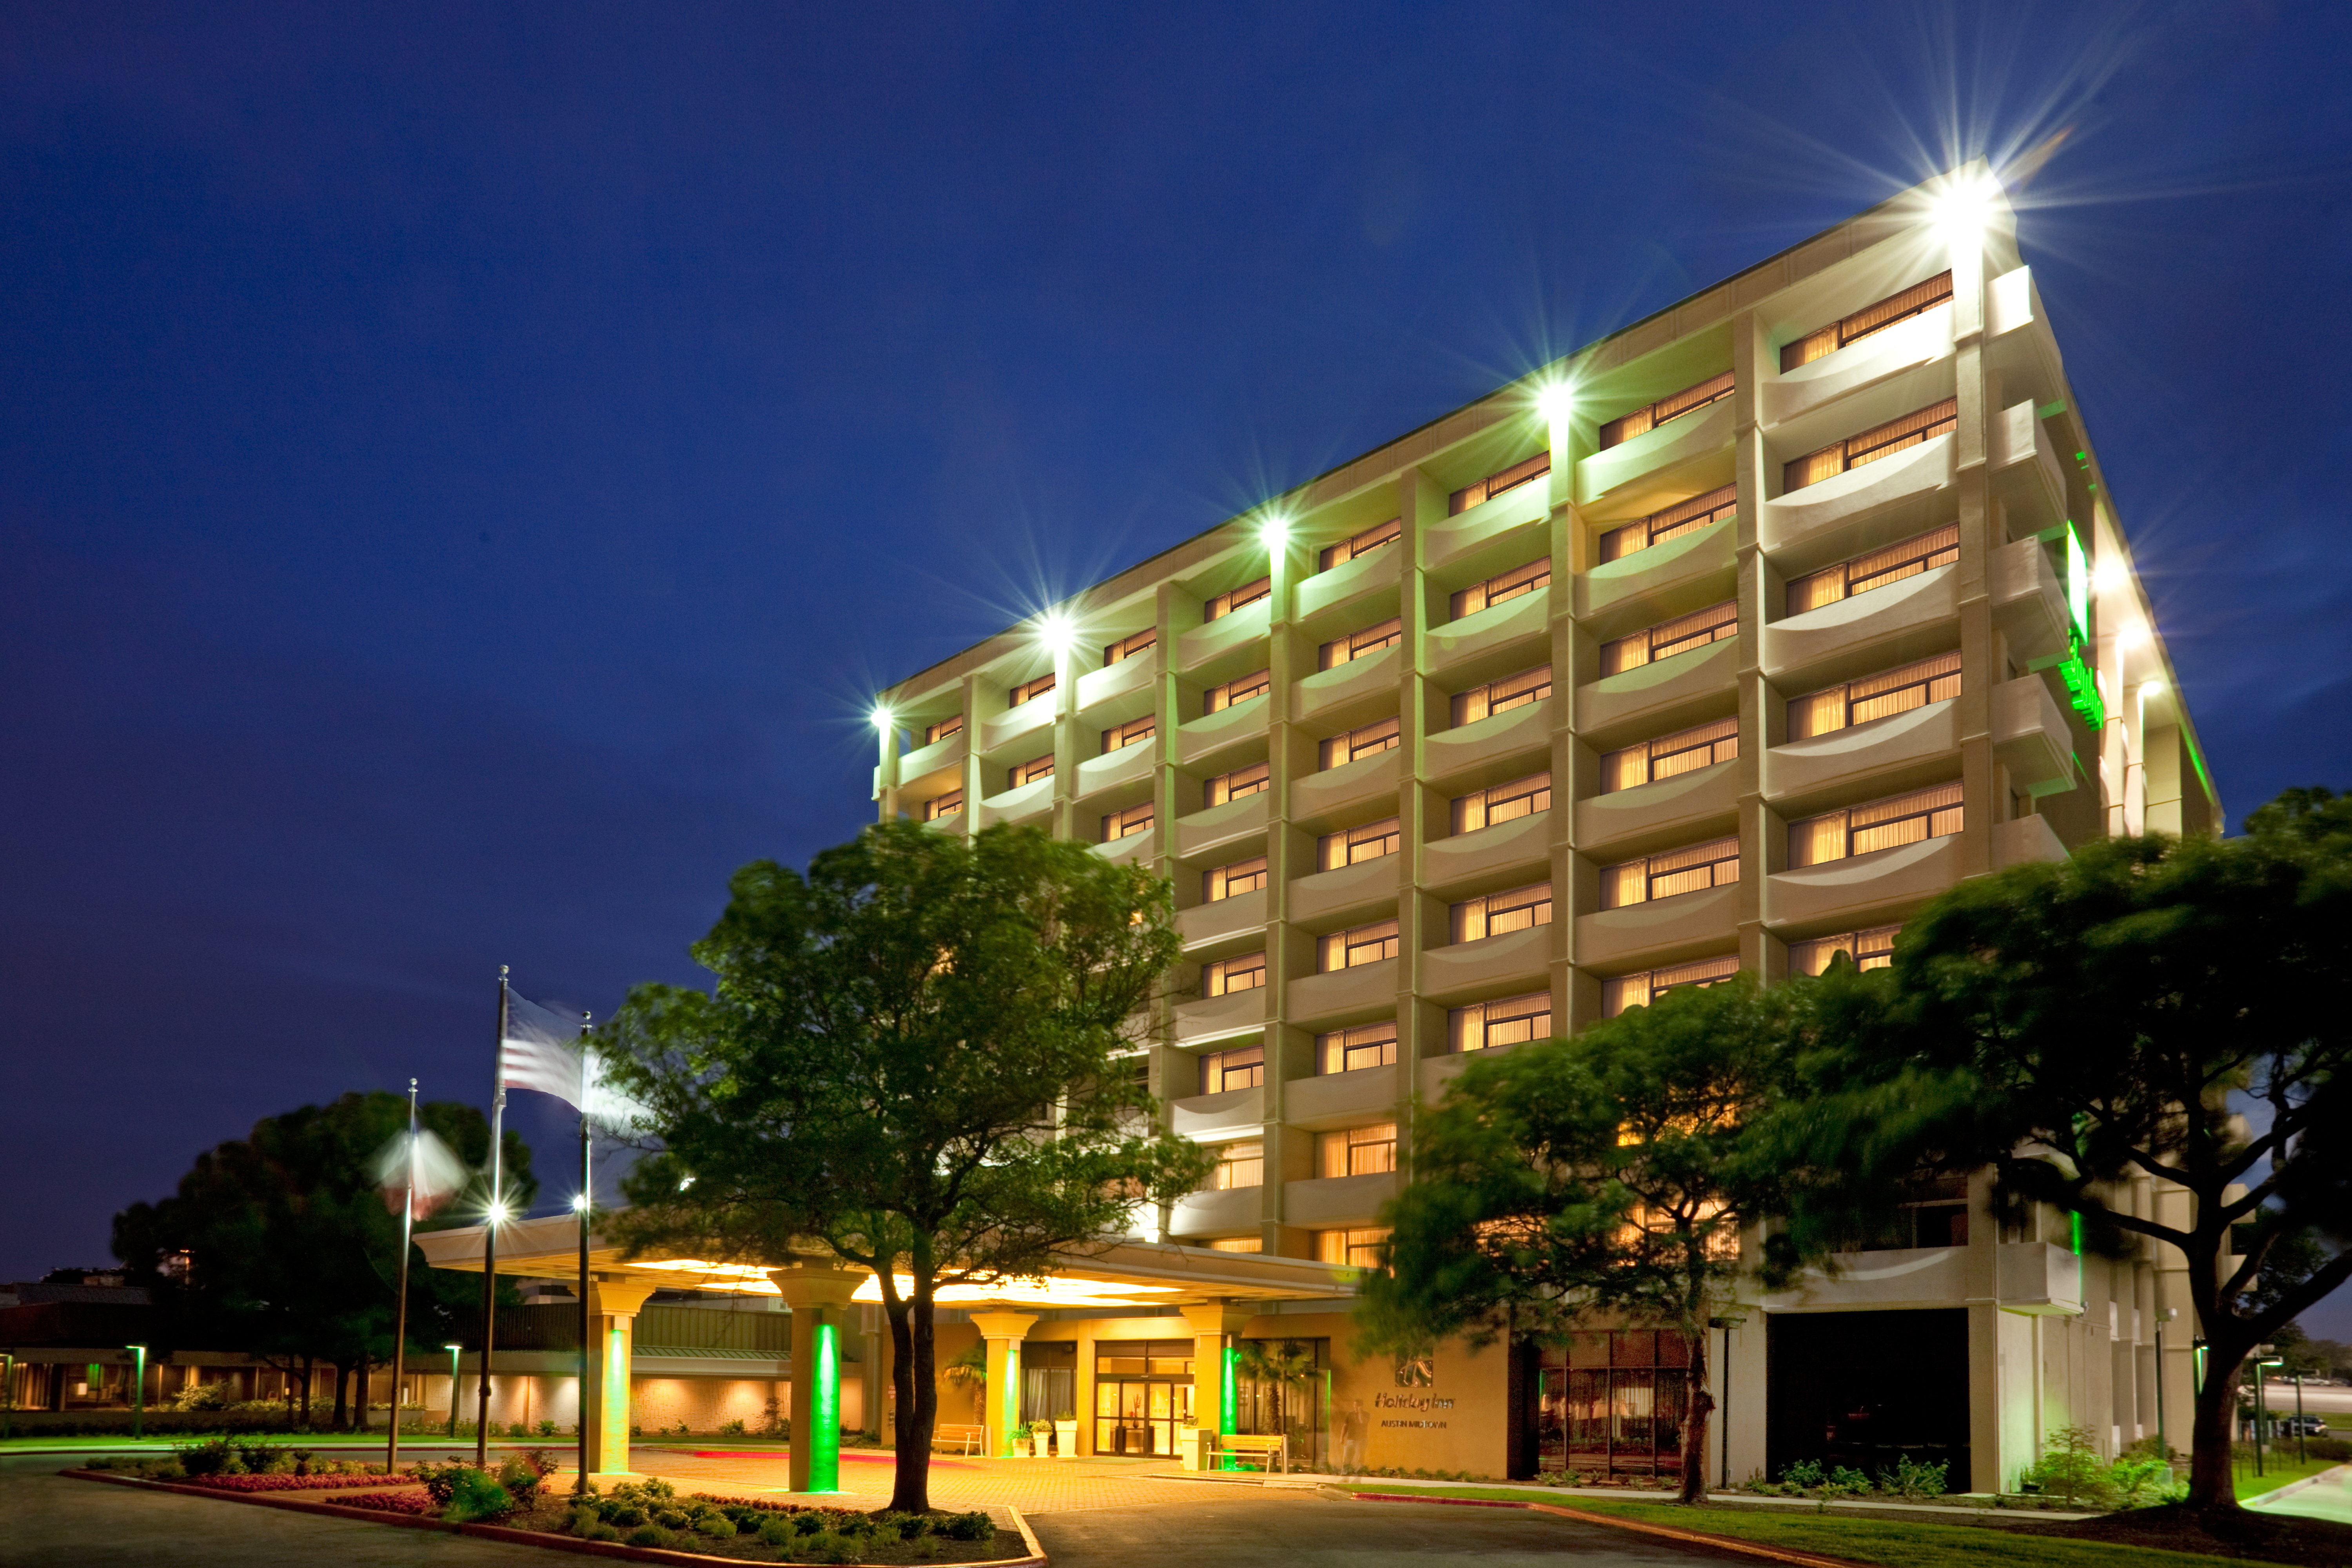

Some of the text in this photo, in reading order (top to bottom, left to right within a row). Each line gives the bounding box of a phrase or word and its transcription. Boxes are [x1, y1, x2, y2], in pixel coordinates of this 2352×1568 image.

[1375, 1392, 1454, 1412] Holiday Inn
[1408, 1420, 1447, 1429] MIDTOWN
